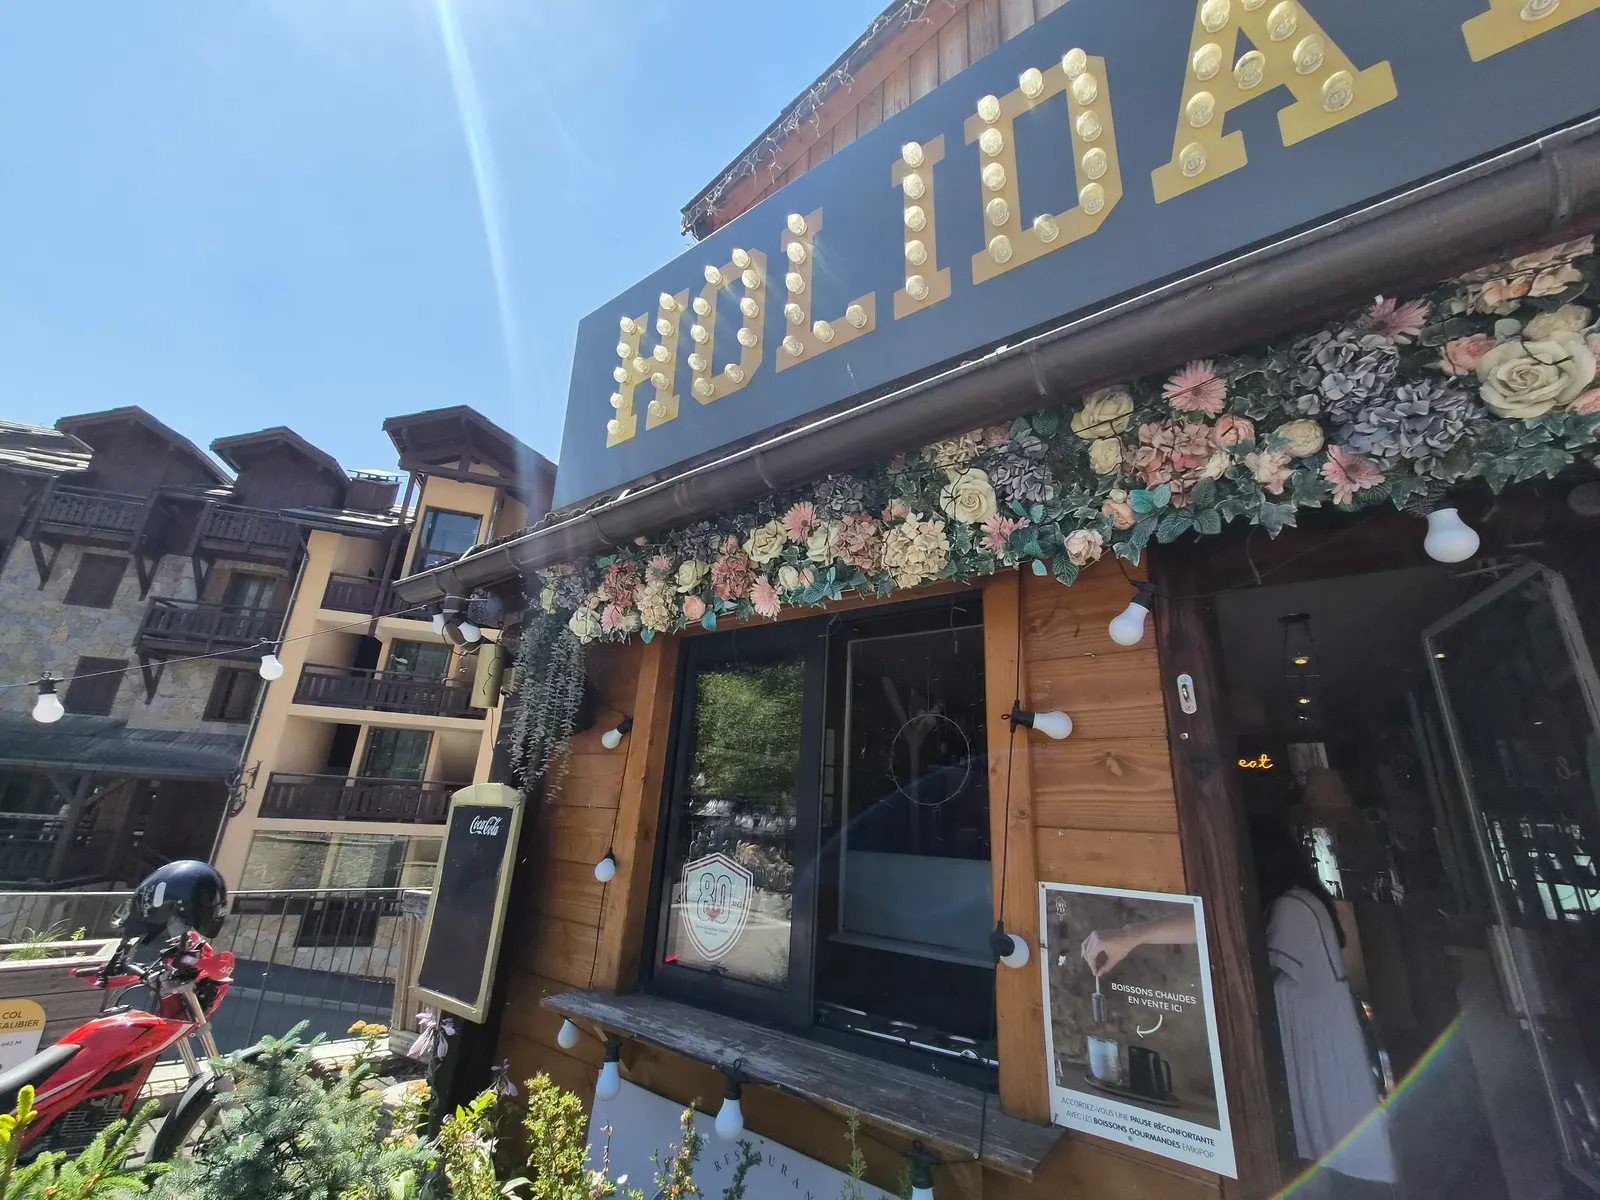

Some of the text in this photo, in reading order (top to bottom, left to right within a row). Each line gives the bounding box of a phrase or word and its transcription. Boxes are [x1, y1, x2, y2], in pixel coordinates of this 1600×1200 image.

[606, 0, 1600, 448] HOLIDA
[1238, 753, 1274, 769] eat
[697, 872, 732, 925] 80
[1111, 982, 1197, 1005] BOISSONS CHAUDES
[1128, 995, 1183, 1013] EN VENTE ICI
[2, 1010, 23, 1020] COL
[1061, 1096, 1216, 1147] ACCORDEZ-VOUS UNE PAUSE RÉCONFORTANTE
[1066, 1109, 1215, 1160] AVEC LES BOISSONS GOURMANDES EMKIPOP
